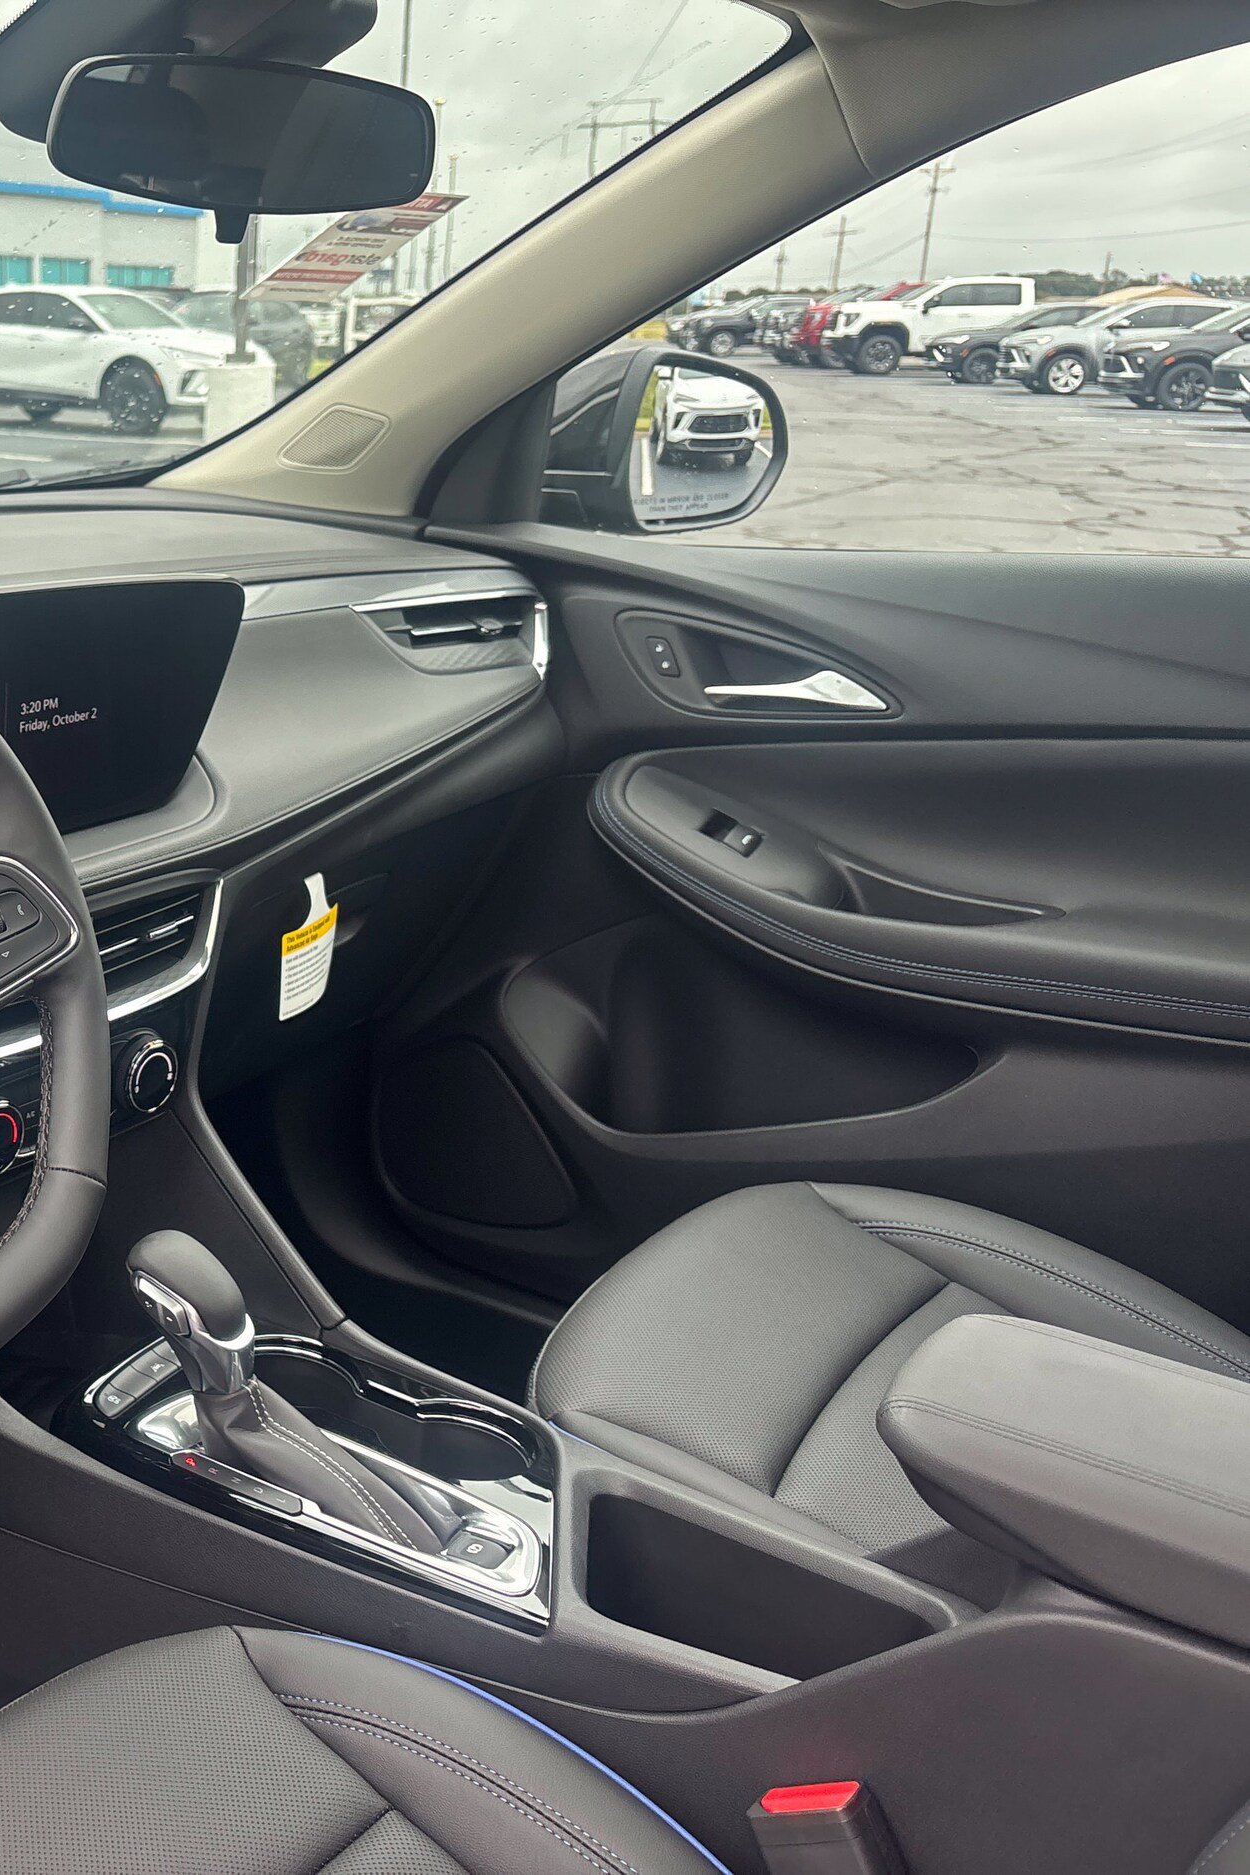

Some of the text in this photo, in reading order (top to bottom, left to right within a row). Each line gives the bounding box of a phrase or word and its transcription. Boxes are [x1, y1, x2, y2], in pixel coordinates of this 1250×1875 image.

[20, 697, 59, 715] 3:20 PM
[19, 707, 98, 733] Friday, October 2
[208, 1467, 219, 1475] R
[253, 1486, 264, 1495] D
[276, 1496, 286, 1504] L
